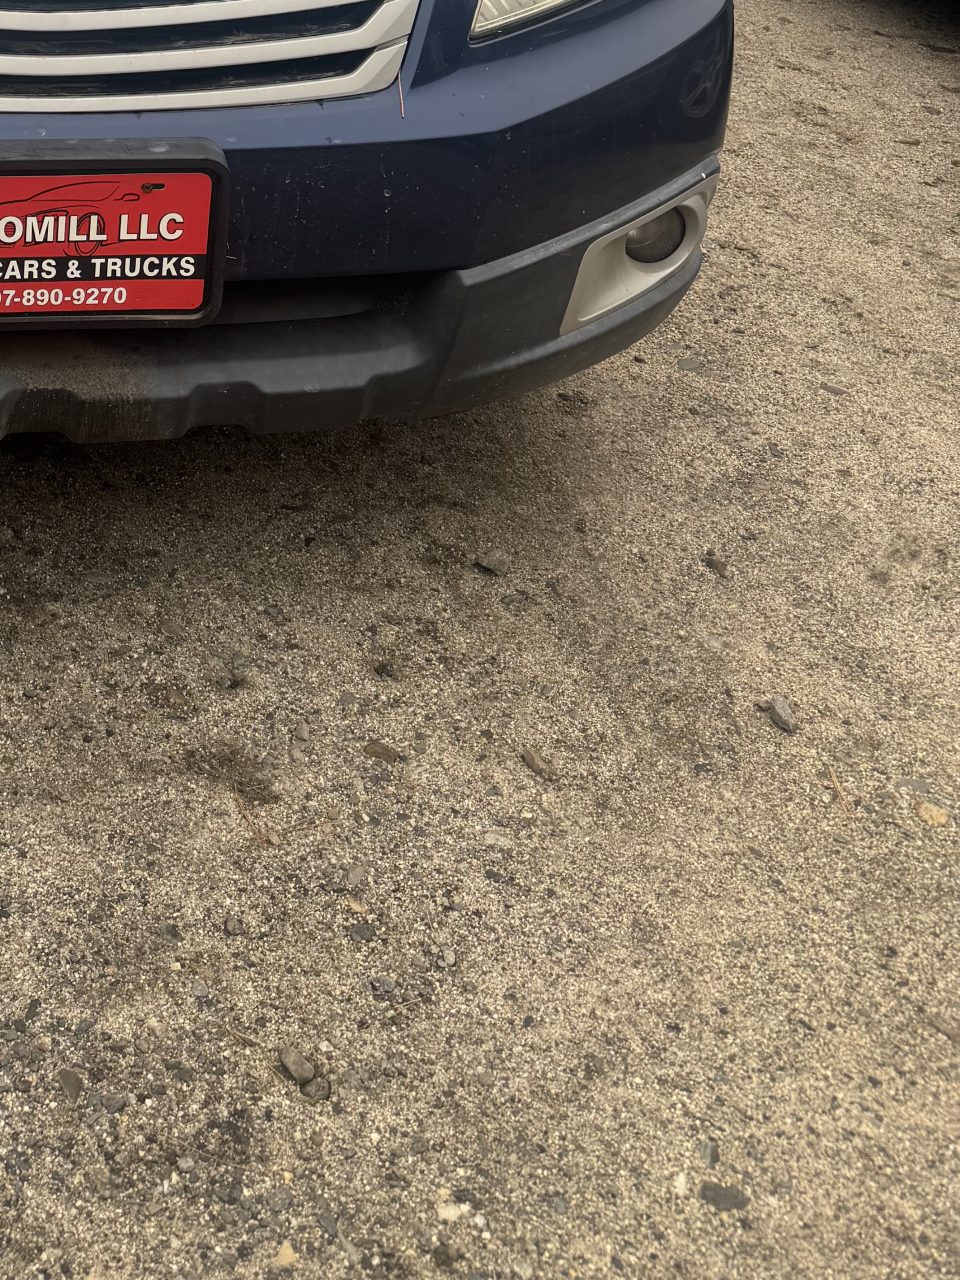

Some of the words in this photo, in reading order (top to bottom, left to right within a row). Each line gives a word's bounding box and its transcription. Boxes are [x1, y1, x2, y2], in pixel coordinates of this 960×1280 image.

[119, 212, 185, 242] LLC
[66, 259, 82, 279] &
[90, 256, 196, 279] TRUCKS
